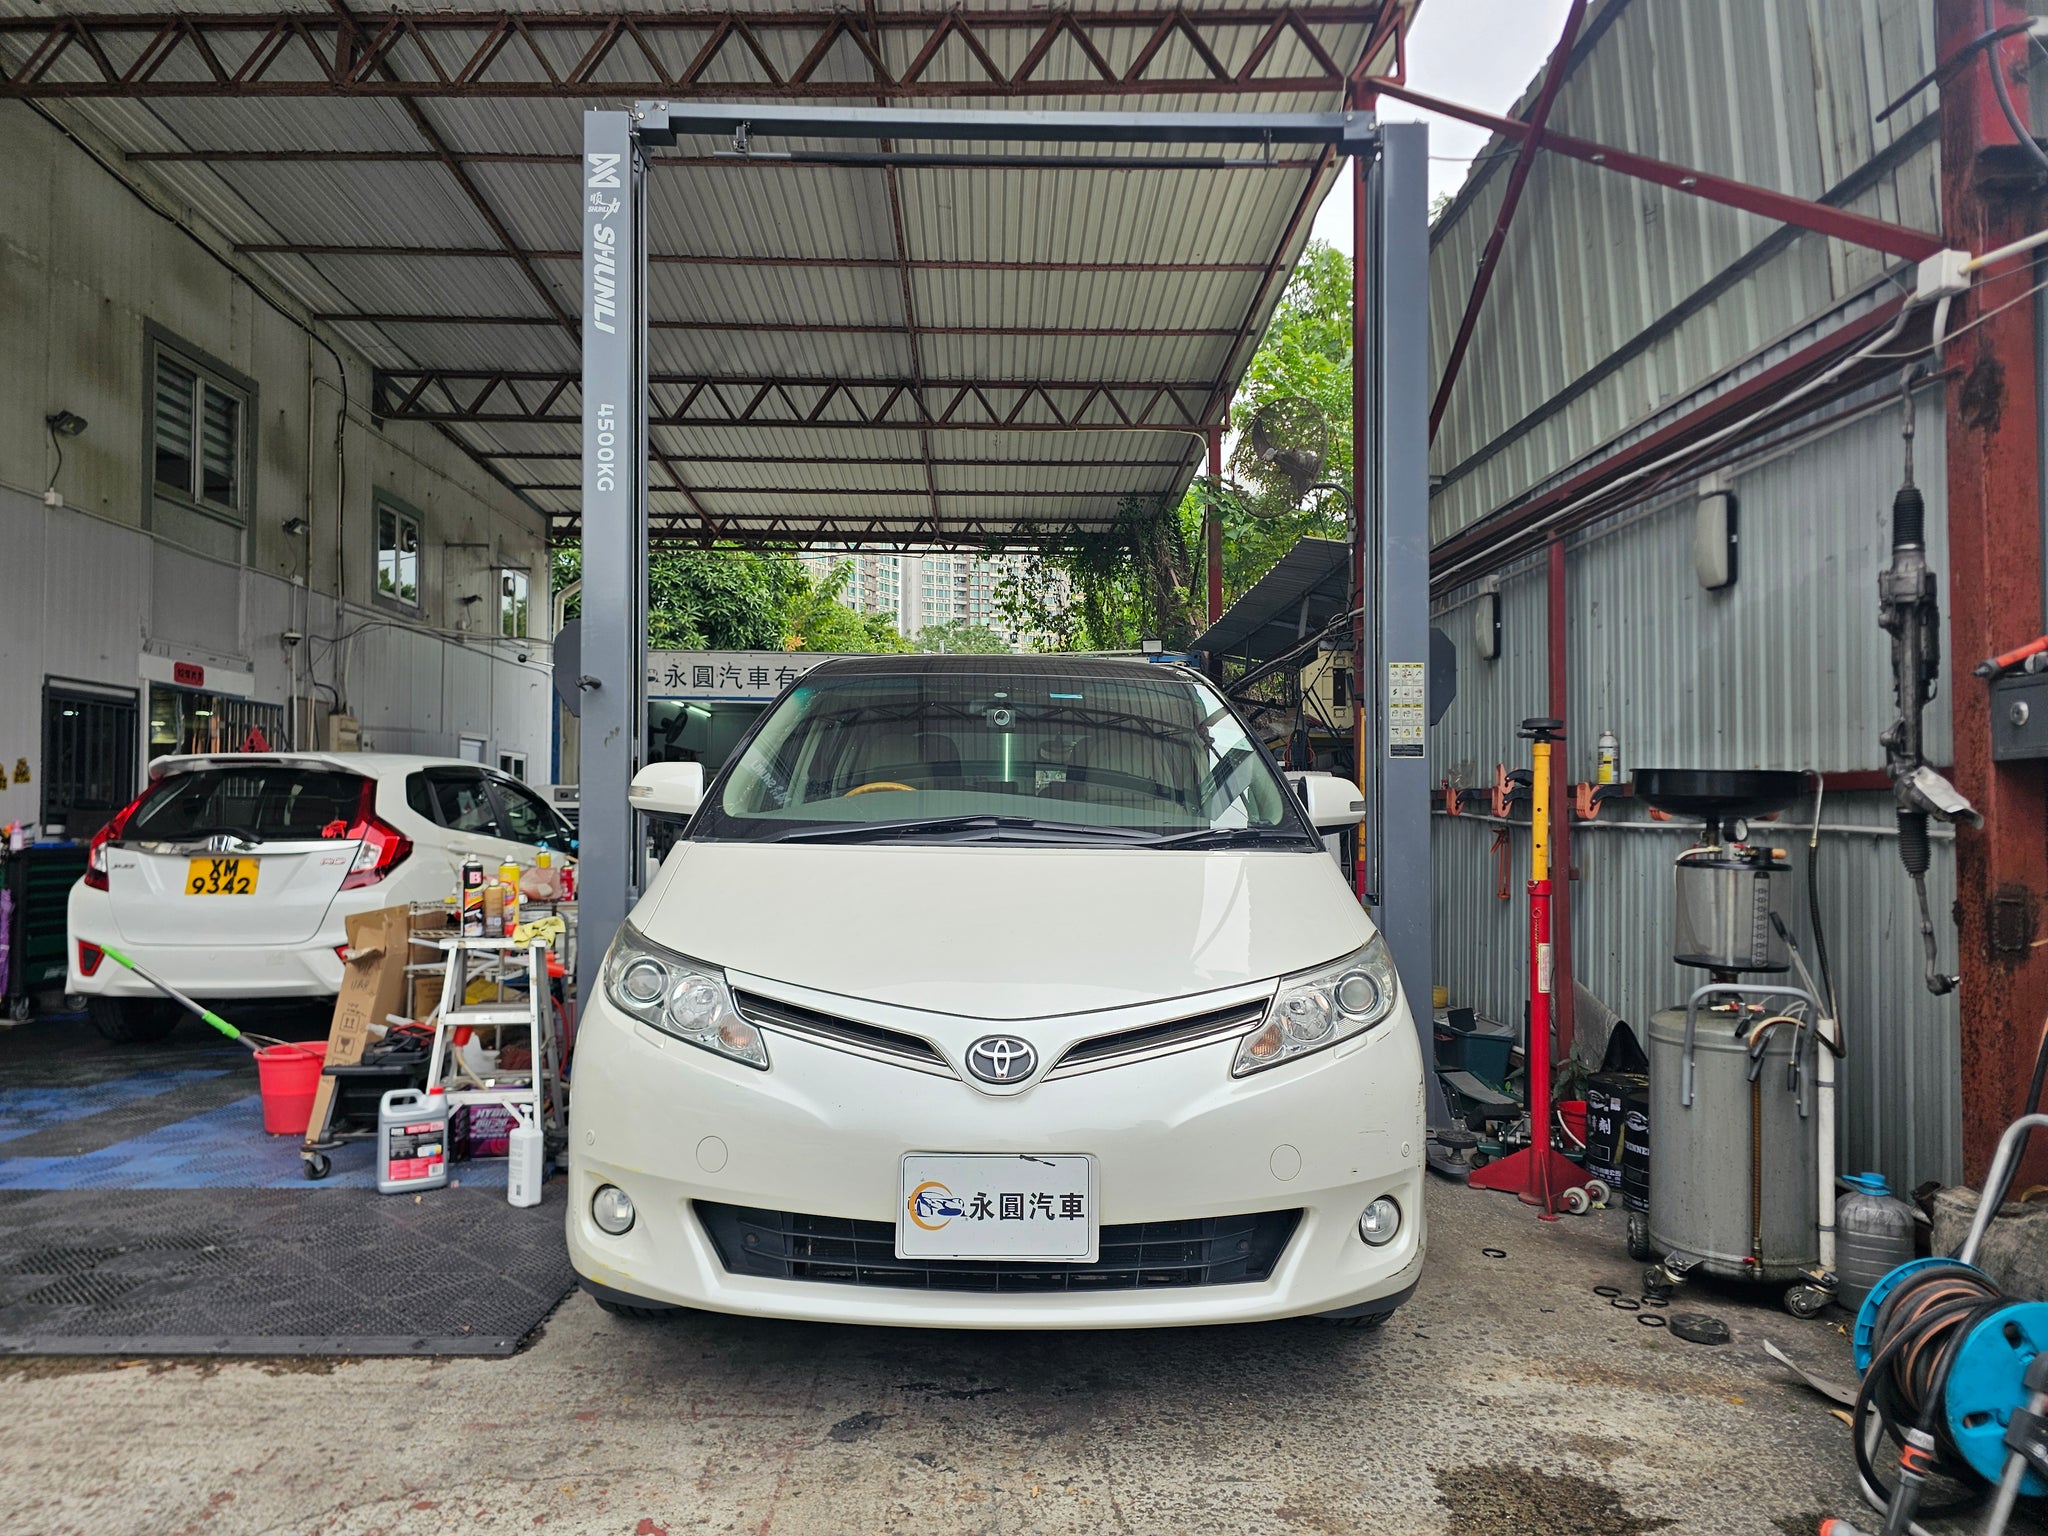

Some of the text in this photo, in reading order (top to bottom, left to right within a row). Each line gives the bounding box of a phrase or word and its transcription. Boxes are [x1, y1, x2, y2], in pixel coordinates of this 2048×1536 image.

[593, 223, 616, 335] SHUNLI
[596, 403, 615, 492] 4500KG
[664, 664, 810, 691] 永圓汽車有
[209, 859, 239, 877] XM
[191, 877, 251, 894] 9342
[969, 1192, 1085, 1221] 永圓汽車
